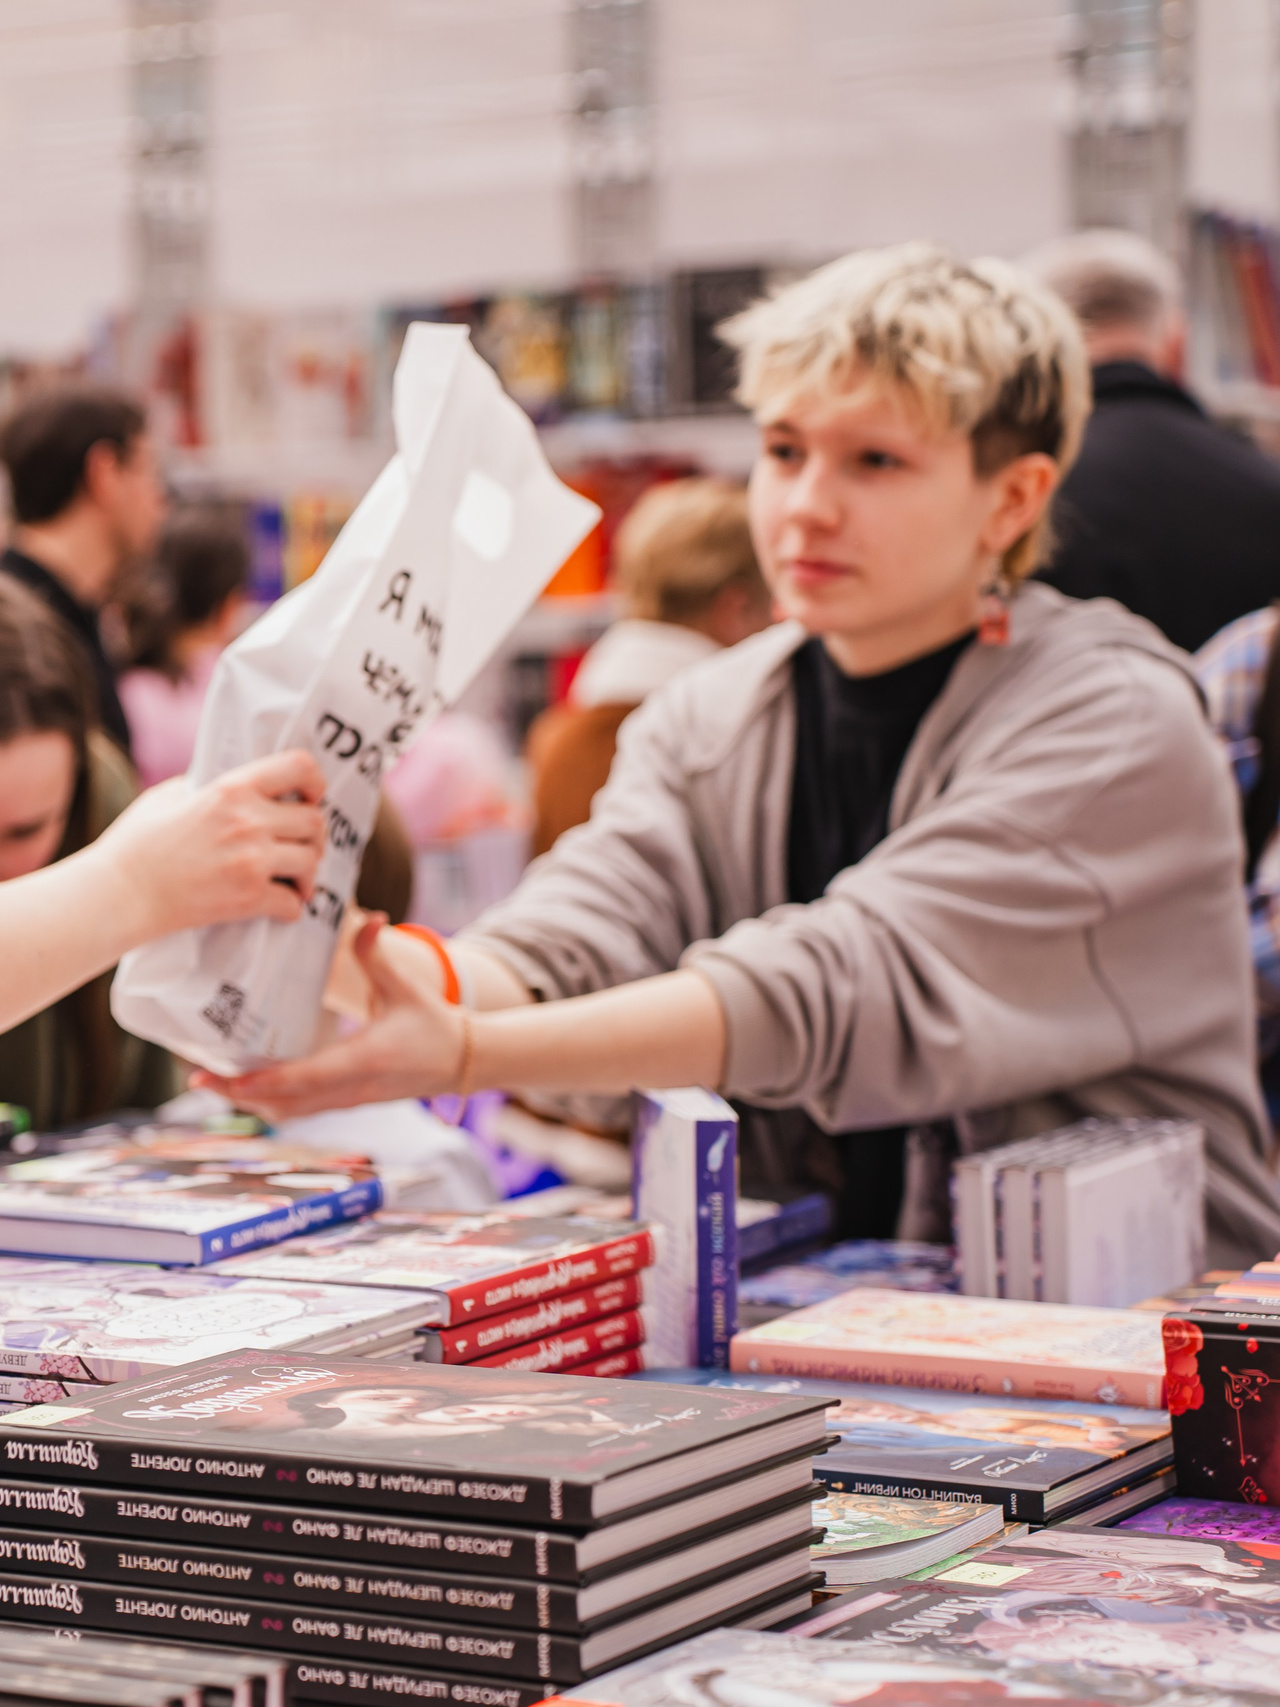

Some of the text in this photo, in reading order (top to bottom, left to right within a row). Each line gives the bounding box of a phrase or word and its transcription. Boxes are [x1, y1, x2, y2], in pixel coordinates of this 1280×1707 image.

[377, 570, 412, 622] Я
[122, 1366, 342, 1421] Кармилла
[4, 1440, 528, 1503] ДЖОЗЕФ ШЕРИДАН ЛЕ ФАНЮ АНТОНИО ЛОРЕНТЕ Кармилла
[852, 1482, 982, 1504] ВАШИНГТОН ИРВИНГ
[117, 1501, 178, 1521] ЛОРЕНТЕ
[181, 1507, 251, 1529] АНТОНИО
[292, 1519, 340, 1539] ФАНЮ
[343, 1524, 364, 1541] ЛЕ
[366, 1526, 441, 1549] ШЕРИДАН
[444, 1535, 513, 1558] ДЖОЗЕФ
[118, 1553, 179, 1573] ЛОРЕНТЕ
[182, 1560, 252, 1581] АНТОНИО
[293, 1571, 341, 1591] ФАНЮ
[344, 1576, 365, 1593] ЛЕ
[368, 1579, 443, 1602] ШЕРИДАН
[115, 1598, 177, 1619] ЛОРЕНТЕ
[445, 1588, 515, 1611] ДЖОЗЕФ
[180, 1605, 251, 1627] АНТОНИО
[292, 1617, 341, 1638] ФАНЮ
[343, 1623, 365, 1641] ЛЕ
[367, 1626, 443, 1650] ШЕРИДАН
[445, 1635, 516, 1659] ДЖОЗЕФ
[297, 1665, 346, 1685] ФАНЮ
[348, 1670, 370, 1689] ЛЕ
[372, 1674, 448, 1698] ШЕРИДАН
[451, 1683, 521, 1707] ДЖОЗЕФ
